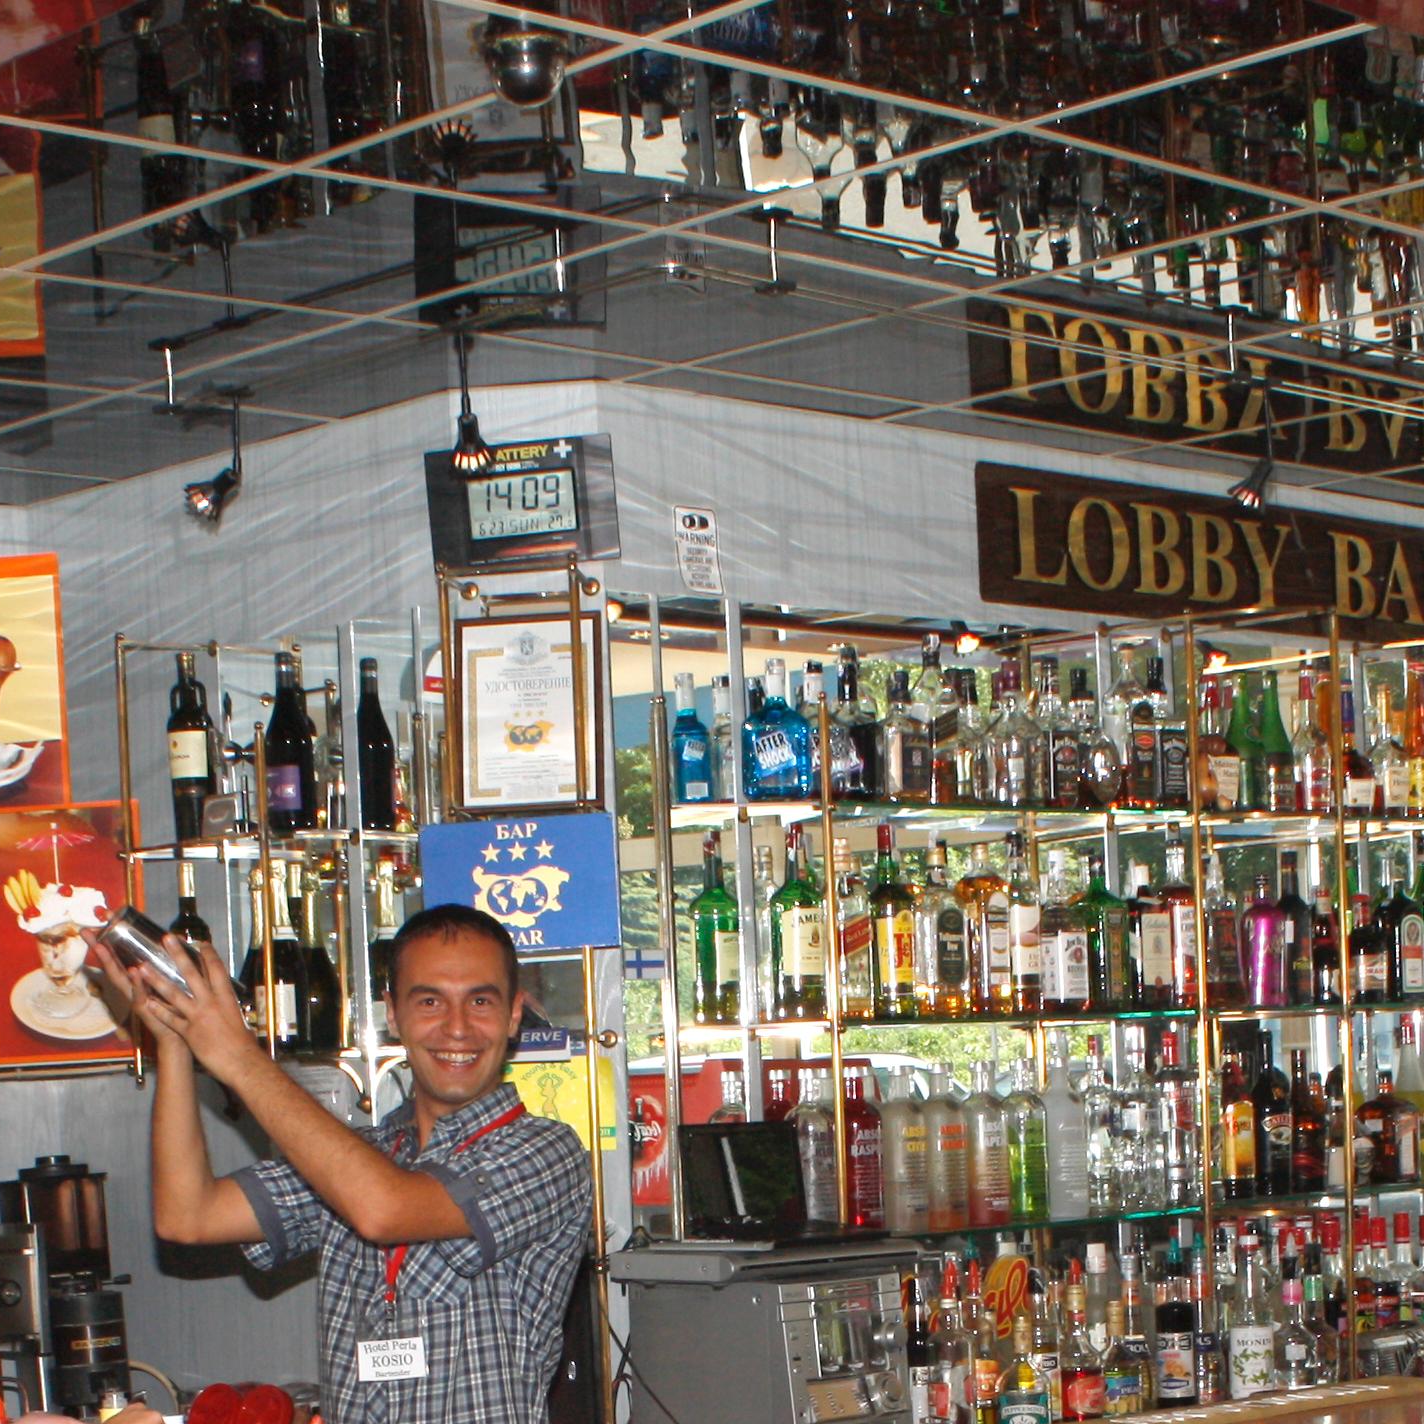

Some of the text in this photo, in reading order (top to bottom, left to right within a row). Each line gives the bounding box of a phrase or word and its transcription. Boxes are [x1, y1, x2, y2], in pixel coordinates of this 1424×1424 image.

[495, 444, 549, 462] ATTERY
[1008, 486, 1291, 609] LOBBY
[485, 677, 571, 695] УДОСТОВЕРЕНИЕ
[755, 733, 785, 754] AFTER
[496, 823, 538, 840] БАР
[521, 1031, 563, 1042] ERVE
[364, 1341, 416, 1354] Hotel Perla
[372, 1353, 413, 1368] KOSIO
